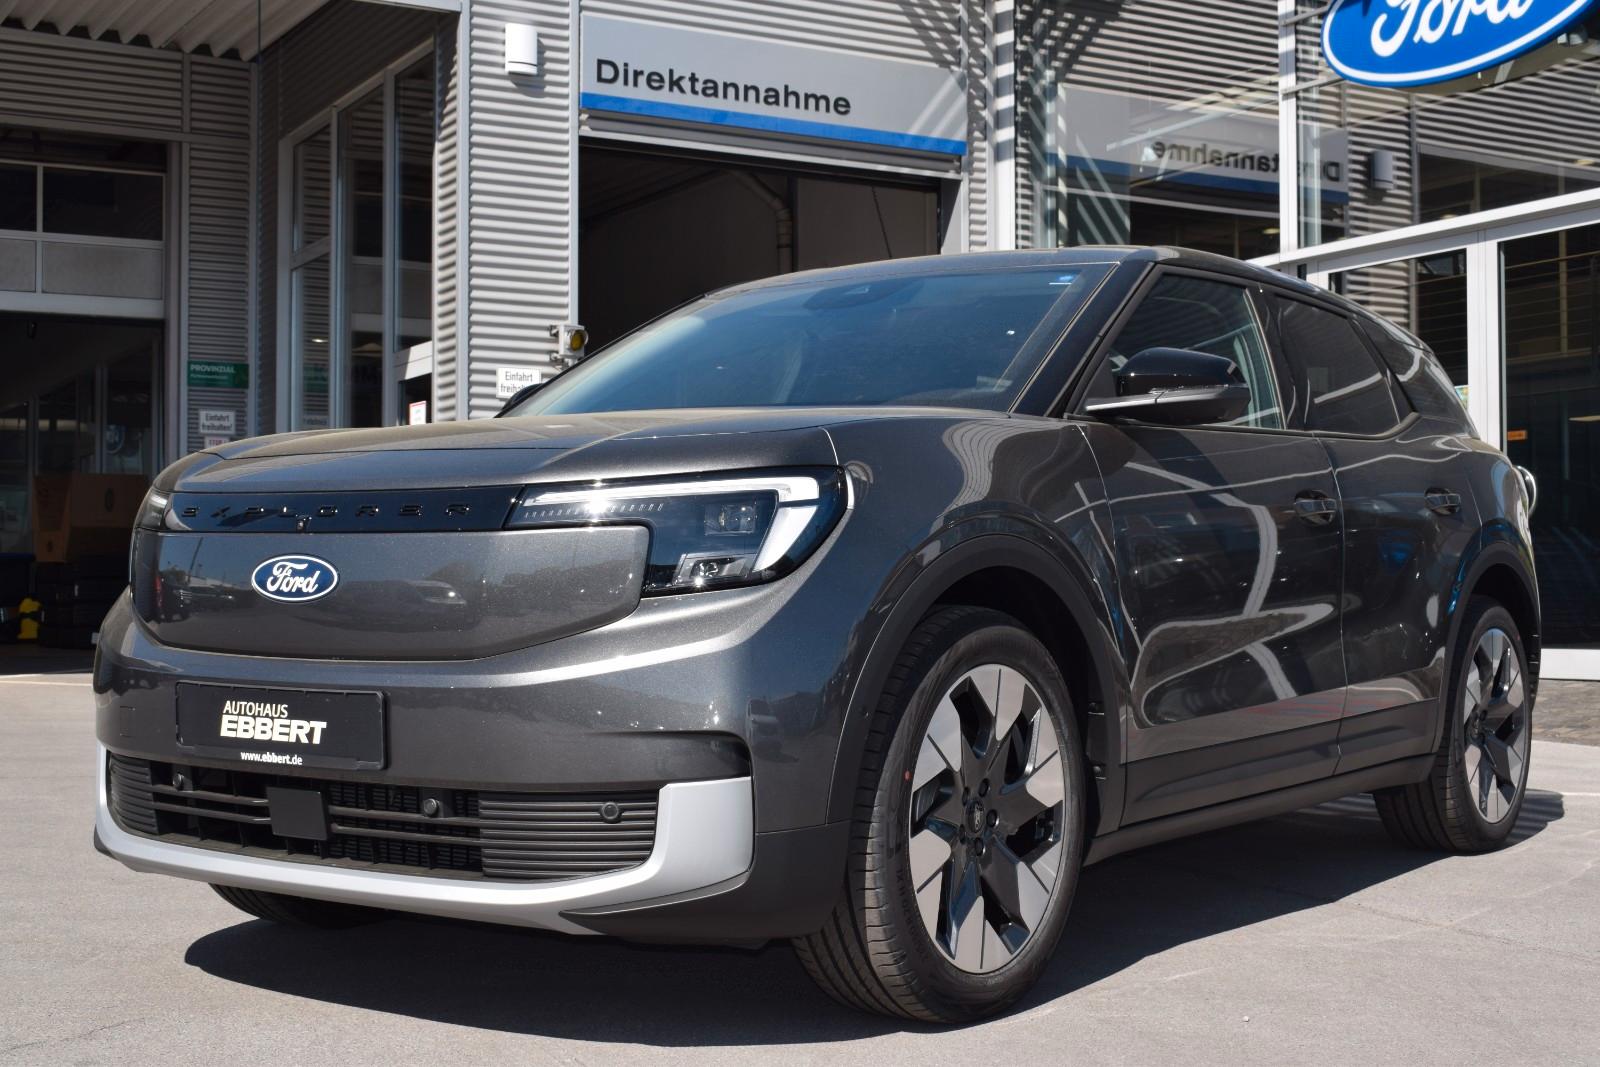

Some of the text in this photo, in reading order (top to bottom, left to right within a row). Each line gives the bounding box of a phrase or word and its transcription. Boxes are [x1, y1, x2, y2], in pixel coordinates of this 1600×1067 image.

[596, 58, 851, 116] Direktannahme
[190, 364, 236, 374] PROVINZIAL
[505, 371, 532, 382] Einfahrt
[205, 412, 230, 422] Einfahrt
[182, 503, 471, 518] EXPLORER
[266, 561, 320, 593] Ford
[223, 700, 288, 718] AUTOHAUS
[220, 714, 327, 744] EBBERT
[240, 751, 303, 765] www.ebbert.de
